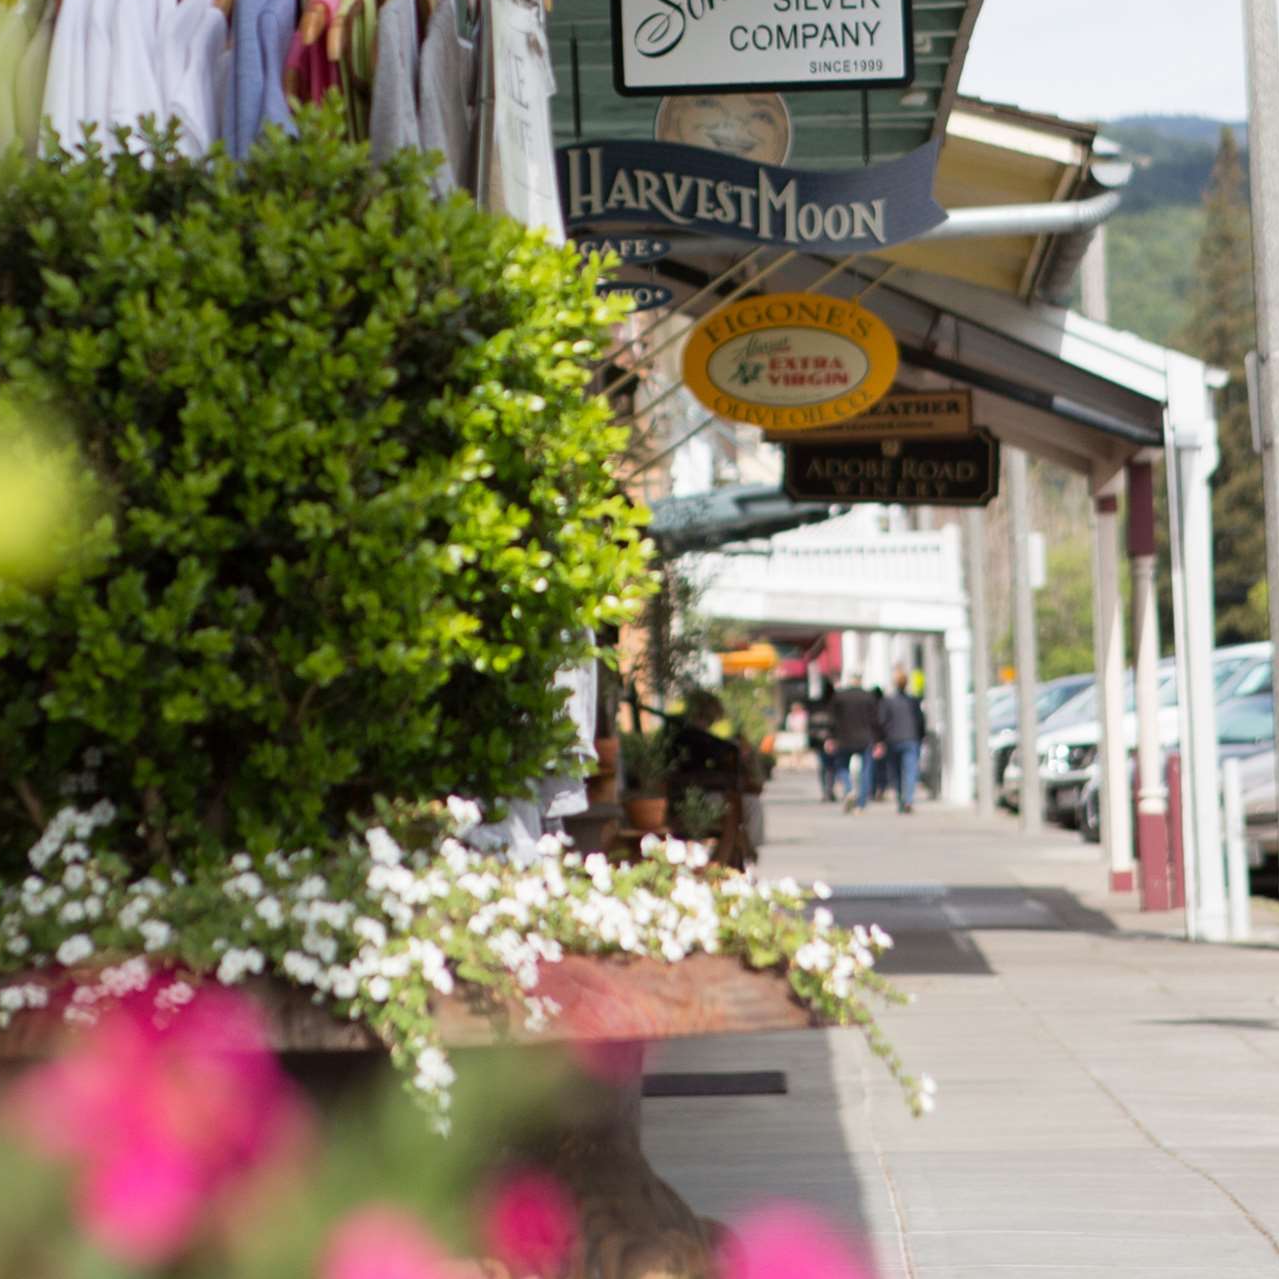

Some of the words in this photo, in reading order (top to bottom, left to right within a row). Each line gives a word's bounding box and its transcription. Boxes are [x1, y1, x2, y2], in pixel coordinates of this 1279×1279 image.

[729, 20, 881, 52] COMPANY
[703, 302, 873, 344] FIGONE'S
[768, 356, 844, 370] EXTRA
[767, 371, 849, 387] VIRGIN
[862, 399, 961, 417] EATHER
[805, 457, 894, 481] ADOBE
[901, 457, 977, 481] ROAD
